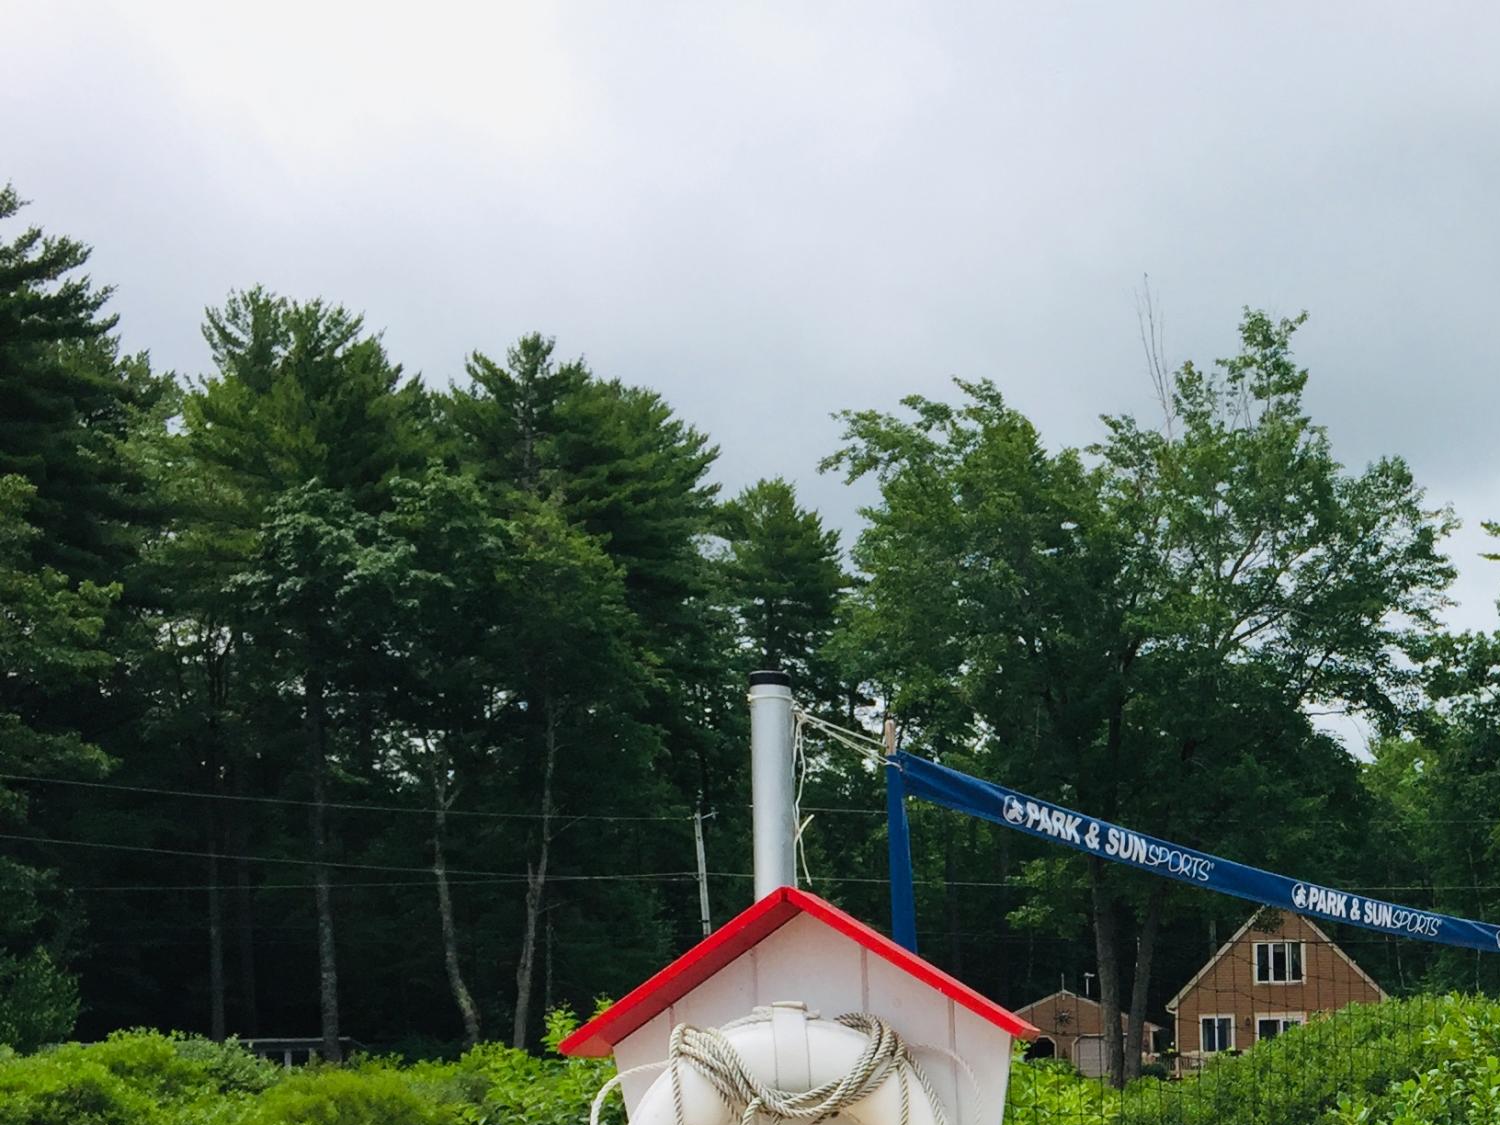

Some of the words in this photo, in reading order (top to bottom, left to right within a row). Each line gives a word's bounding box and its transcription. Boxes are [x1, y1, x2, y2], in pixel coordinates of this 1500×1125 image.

[1025, 801, 1082, 844] PARK
[1084, 822, 1099, 850] &
[1308, 886, 1347, 918] PARK
[1350, 898, 1360, 921] &
